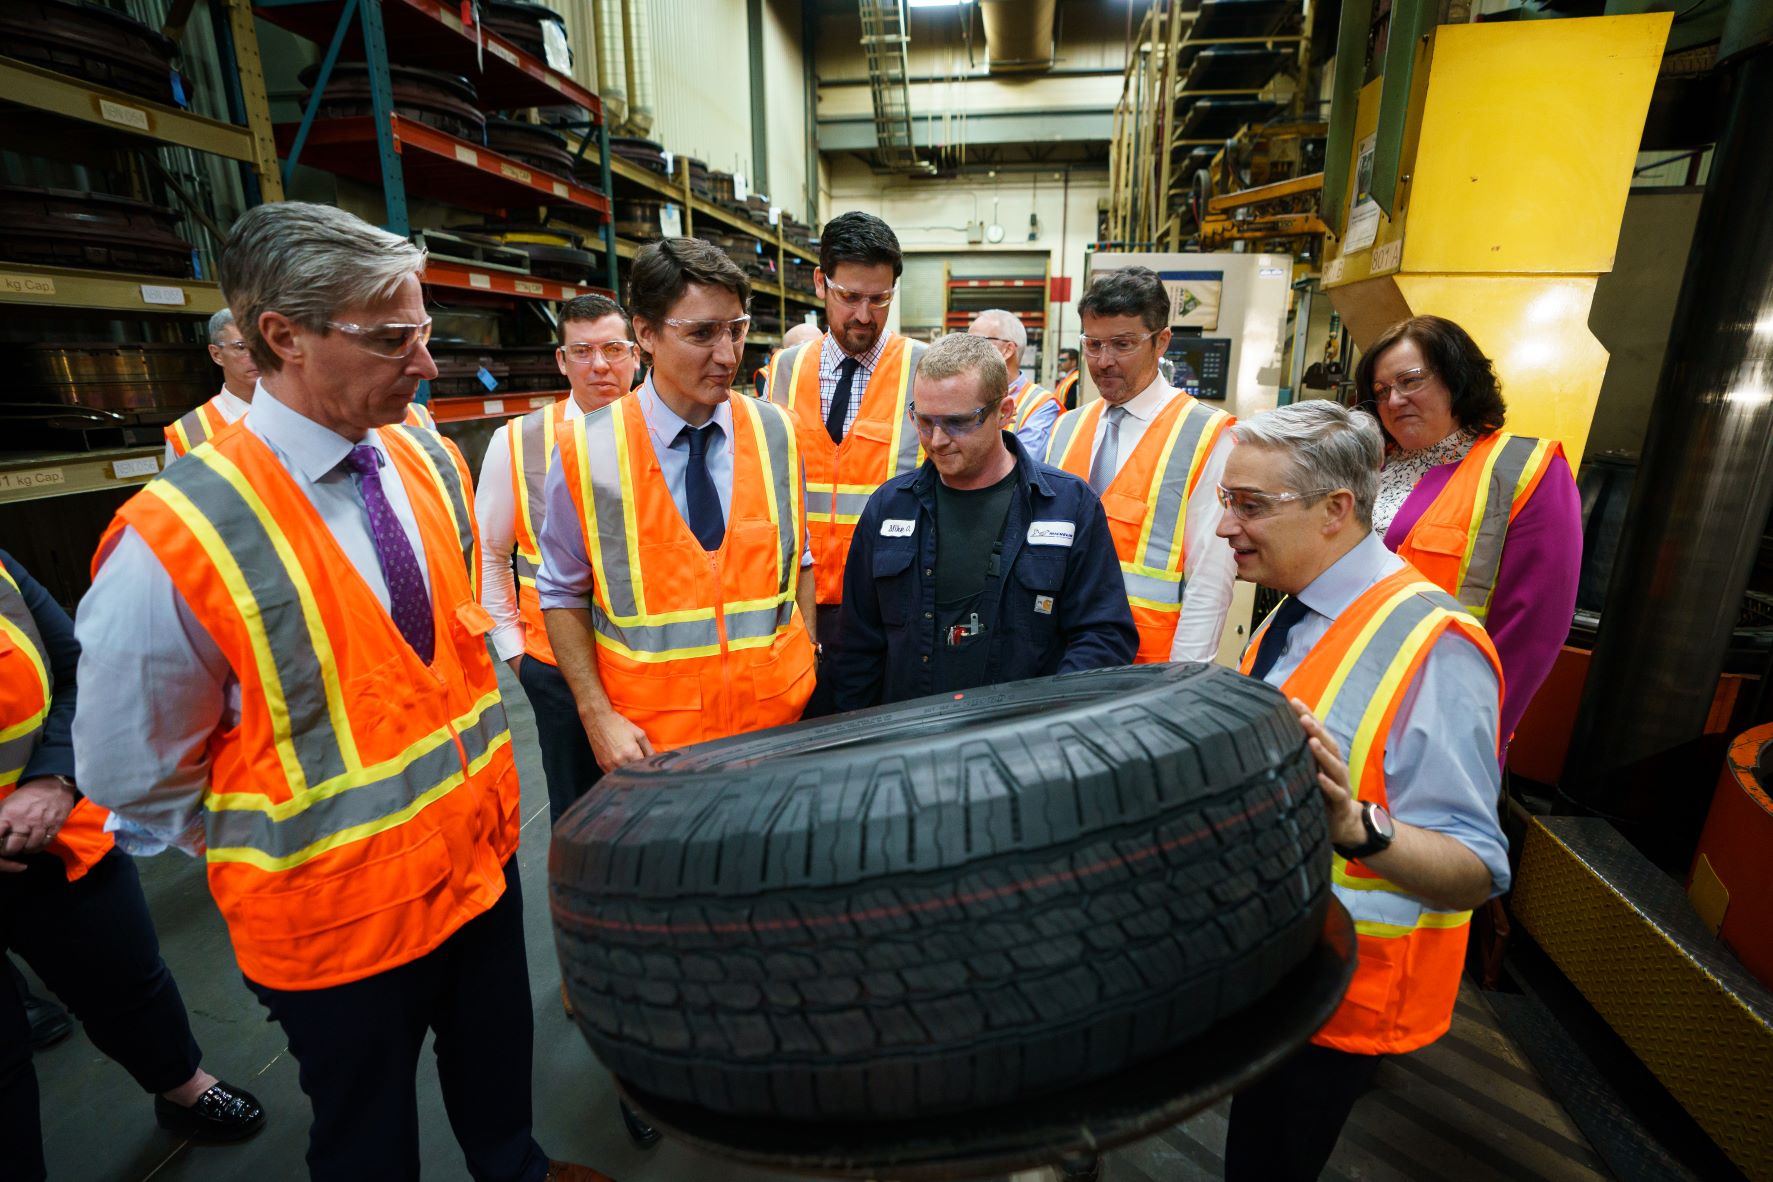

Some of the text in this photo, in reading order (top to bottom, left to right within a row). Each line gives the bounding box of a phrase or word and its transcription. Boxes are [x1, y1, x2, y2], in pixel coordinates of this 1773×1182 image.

[1390, 243, 1399, 267] A
[5, 278, 54, 292] kg Cap.
[17, 475, 31, 486] kg
[35, 472, 63, 483] Cap.
[888, 524, 905, 533] Mike
